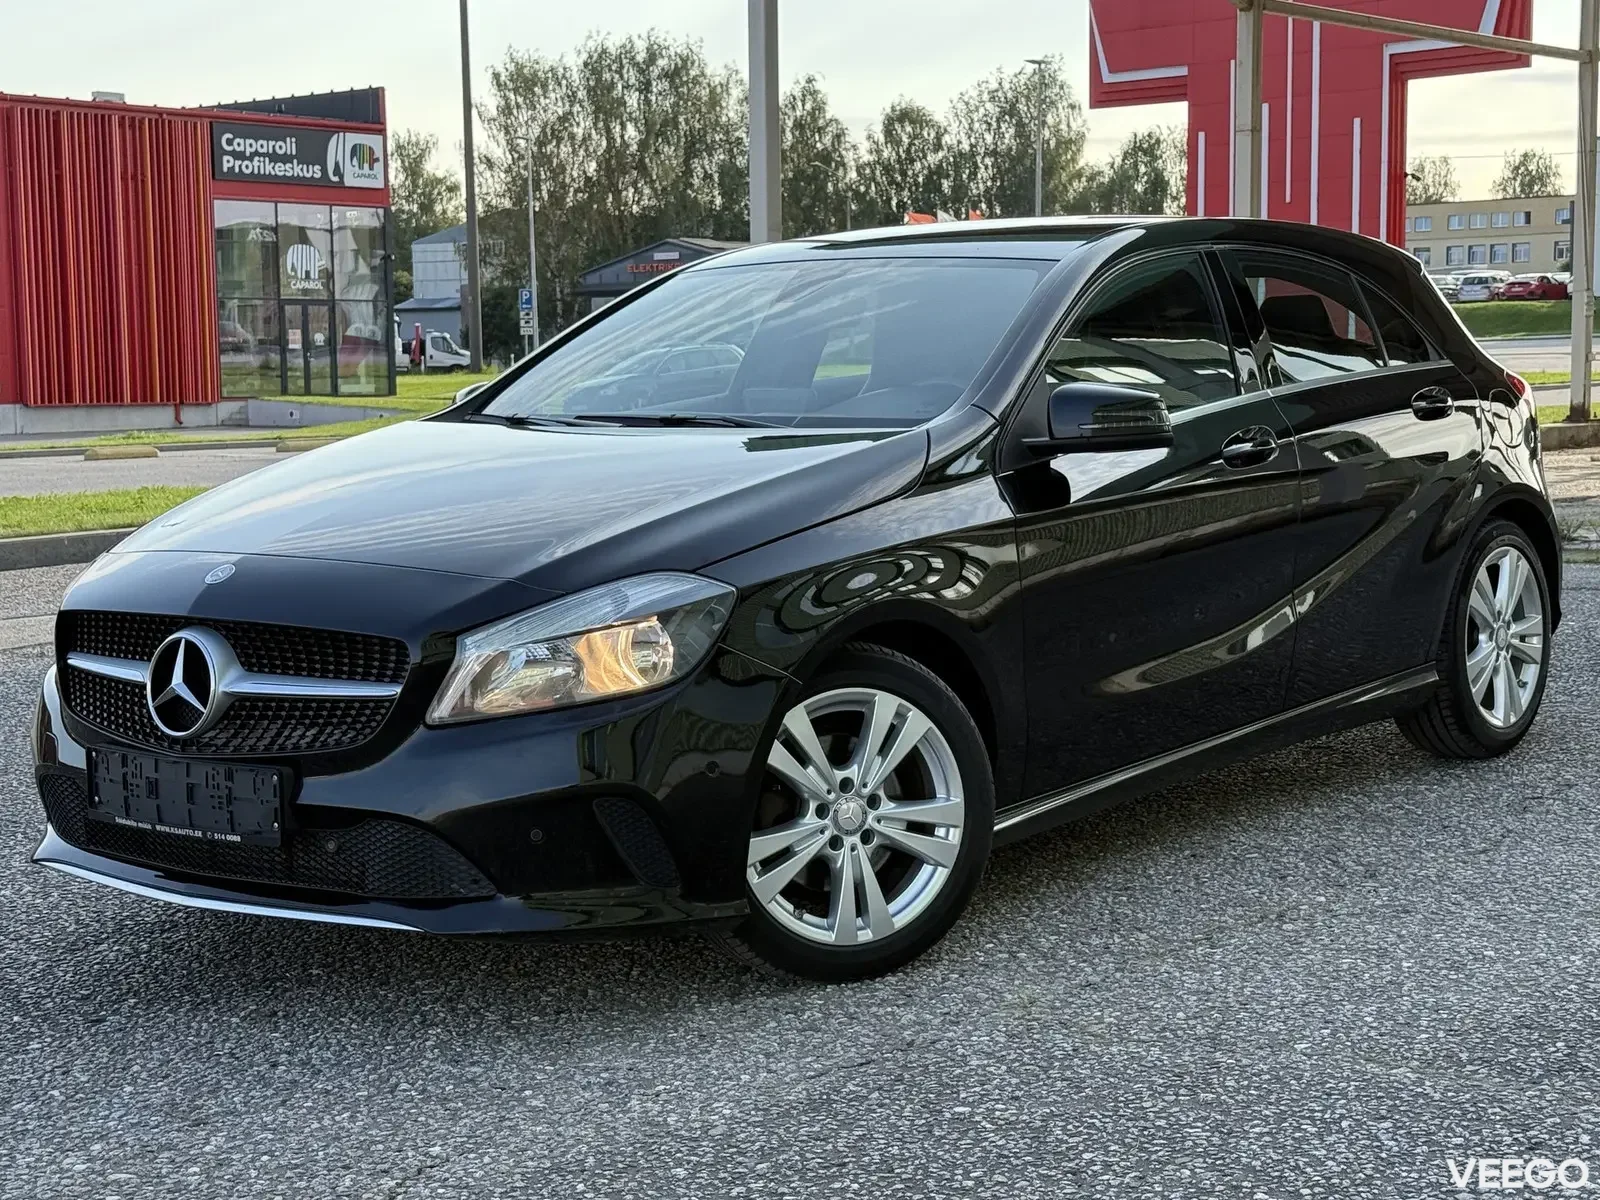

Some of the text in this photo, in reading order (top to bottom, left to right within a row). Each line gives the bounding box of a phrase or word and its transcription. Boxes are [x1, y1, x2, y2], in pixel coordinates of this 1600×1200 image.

[221, 133, 296, 156] Caparoli
[222, 156, 322, 179] Profikeskus
[352, 172, 379, 180] CAPAROL
[627, 262, 684, 273] ELEKTRIK
[290, 280, 324, 289] CAPAROL
[522, 291, 530, 303] P
[214, 832, 225, 840] 514
